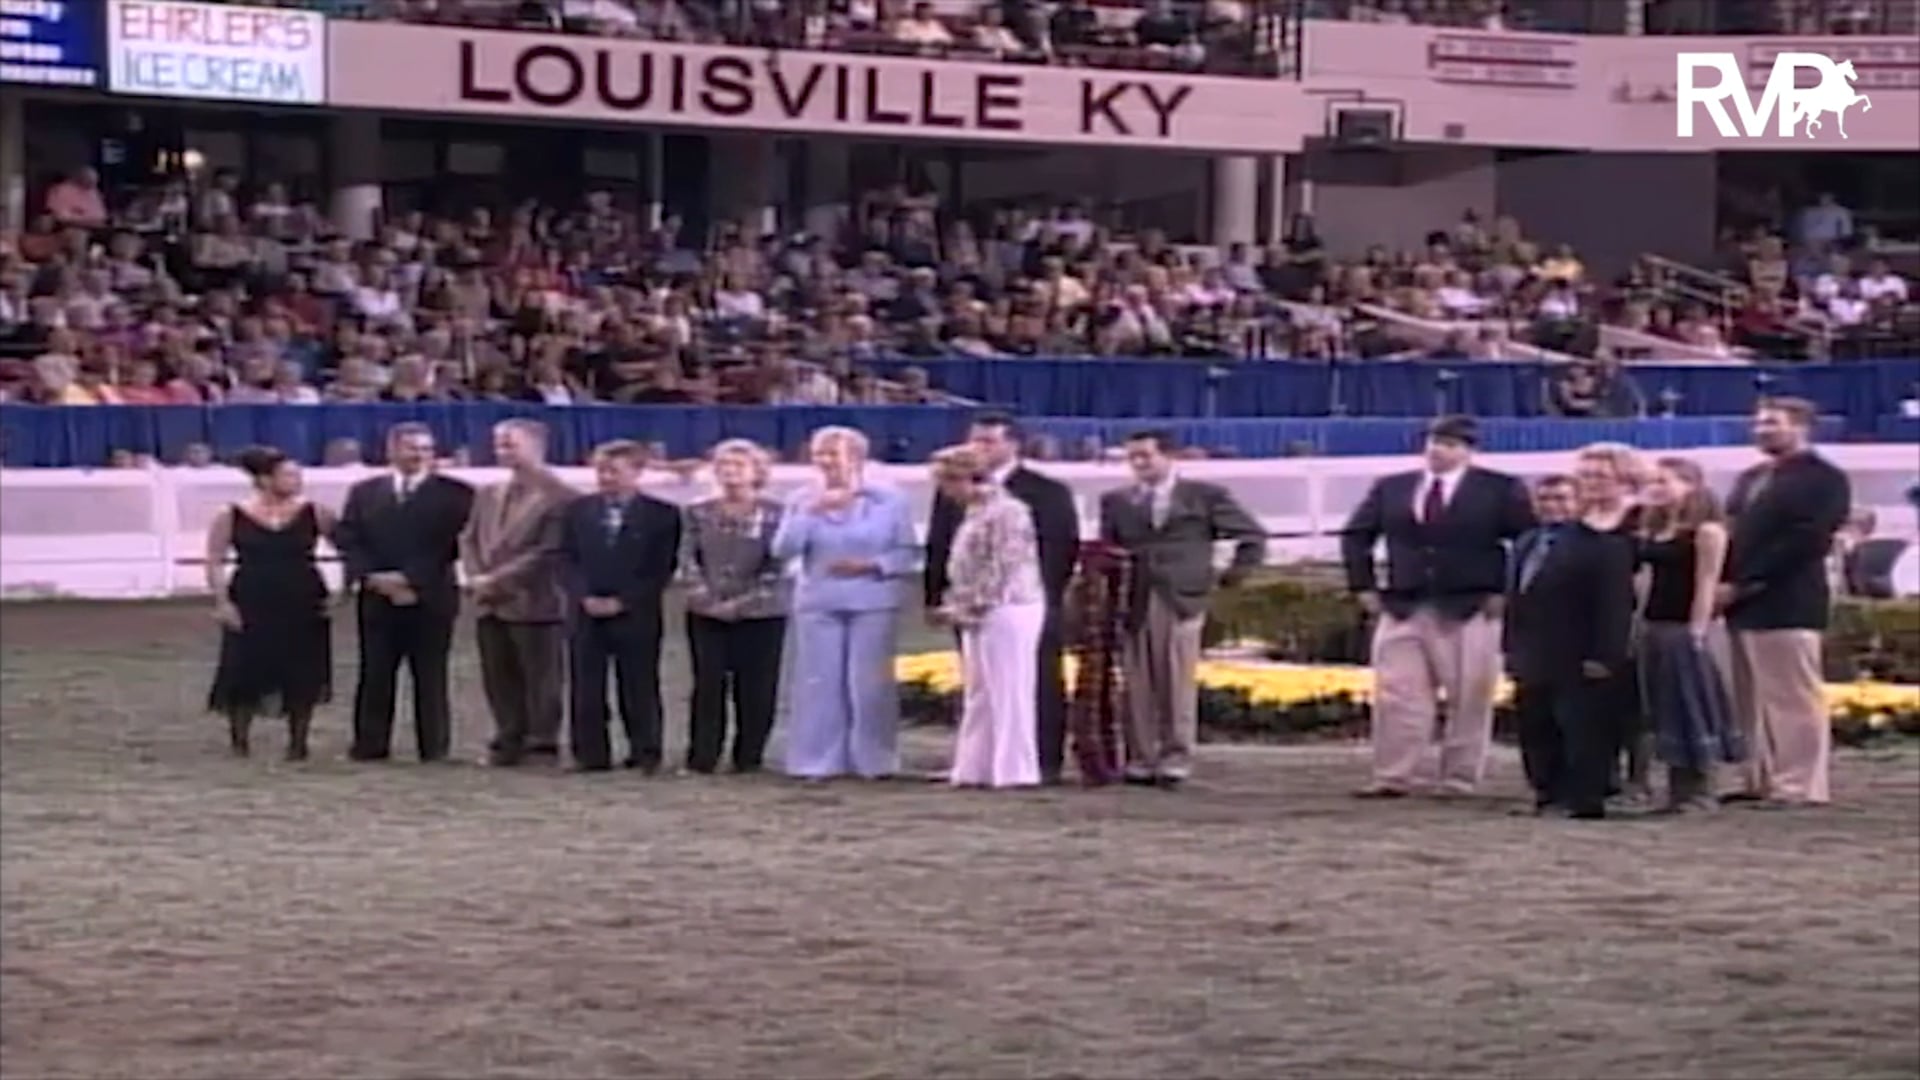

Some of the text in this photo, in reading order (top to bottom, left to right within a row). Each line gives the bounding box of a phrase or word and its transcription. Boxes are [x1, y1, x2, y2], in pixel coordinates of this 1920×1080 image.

[125, 50, 177, 88] ICE
[183, 54, 304, 99] CREAM
[460, 41, 1192, 136] LOUISVILLE KY
